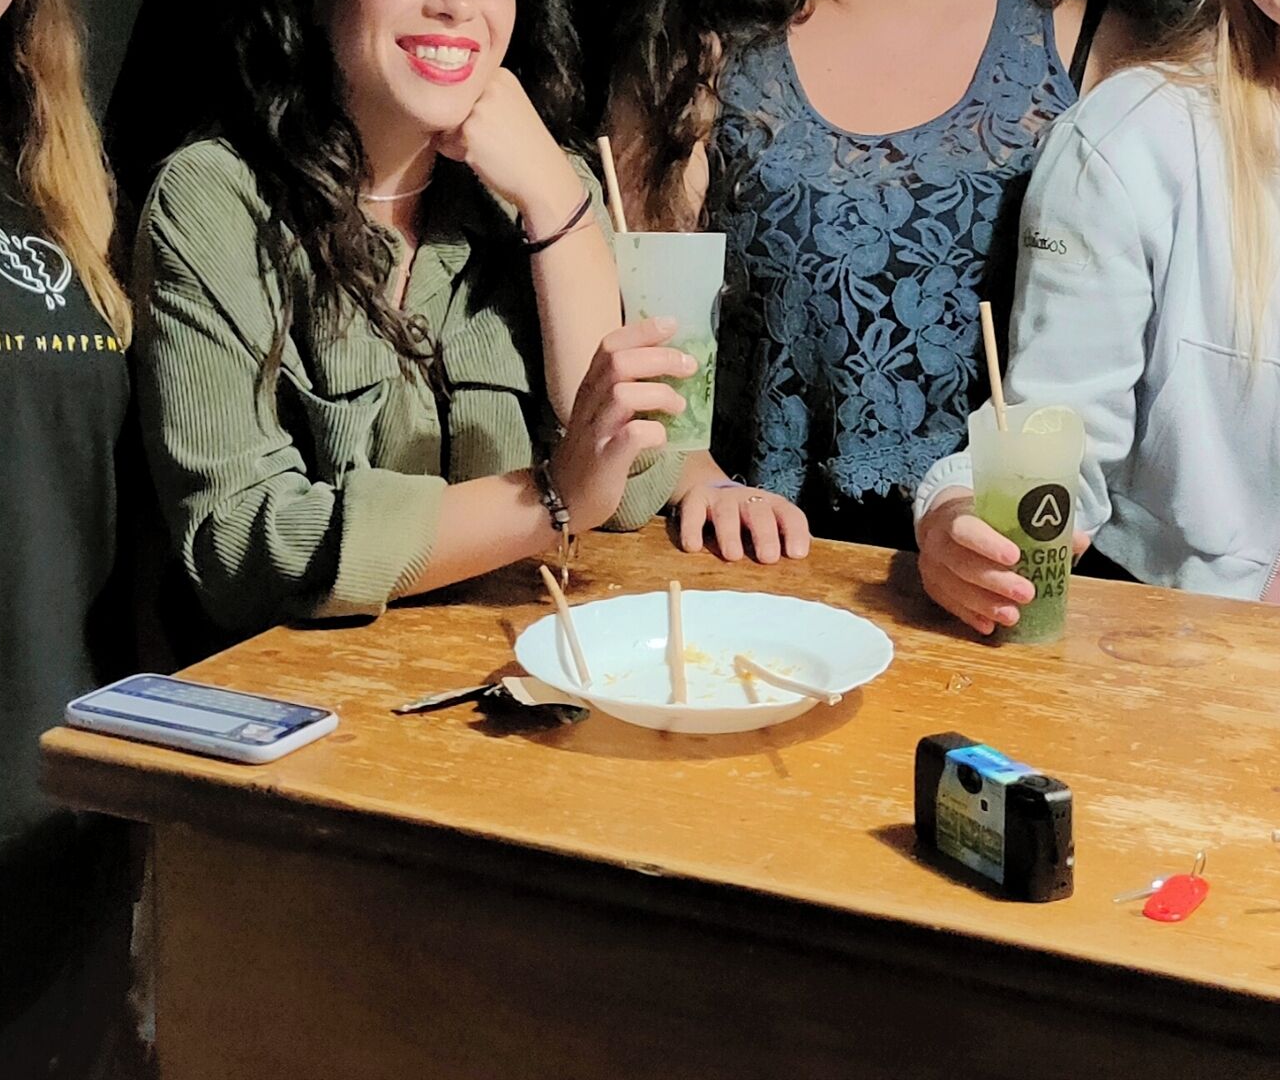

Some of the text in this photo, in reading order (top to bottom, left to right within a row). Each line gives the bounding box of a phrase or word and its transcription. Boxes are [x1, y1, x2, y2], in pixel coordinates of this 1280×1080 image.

[36, 333, 118, 353] HAPPEN
[1020, 545, 1068, 566] AGRO
[1035, 580, 1065, 599] IAS
